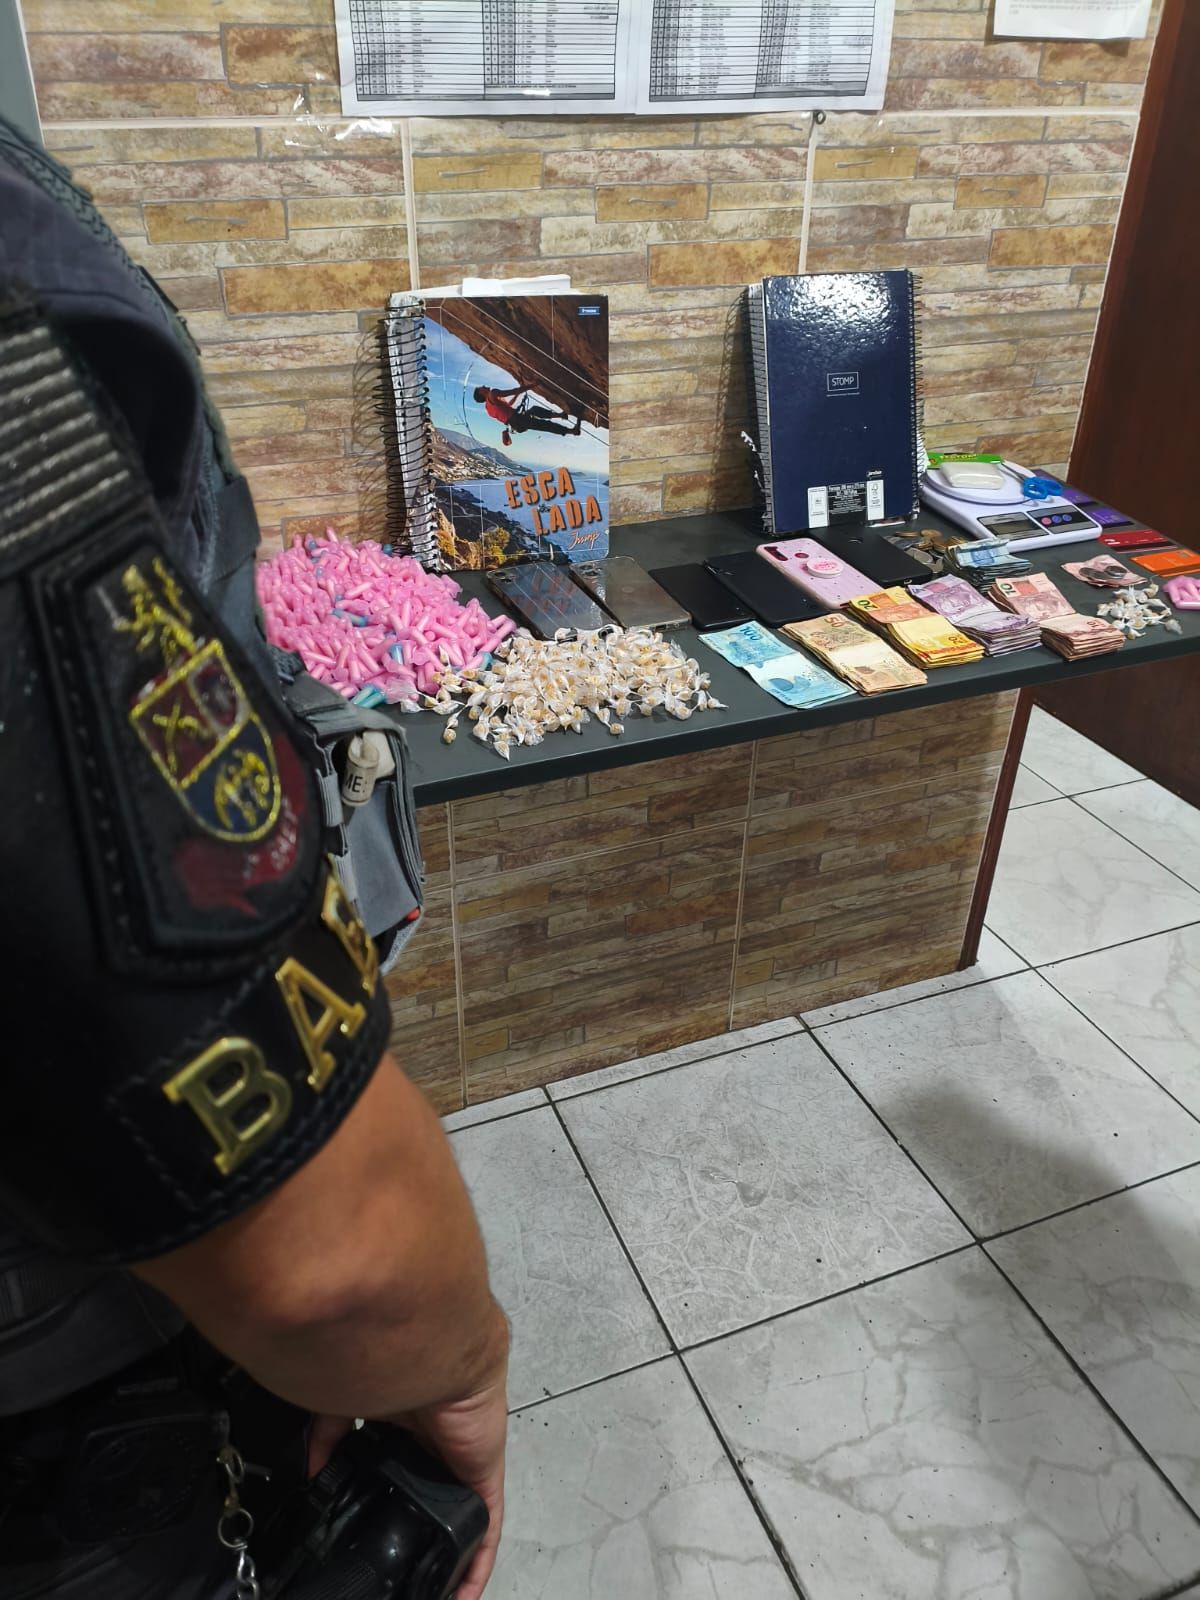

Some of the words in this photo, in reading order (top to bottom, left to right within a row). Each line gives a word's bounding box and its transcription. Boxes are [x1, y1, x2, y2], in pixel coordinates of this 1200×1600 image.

[831, 376, 855, 387] STOMP
[505, 466, 576, 509] ESCA
[532, 495, 603, 537] LADA
[1000, 582, 1016, 596] 10
[823, 616, 845, 628] 50
